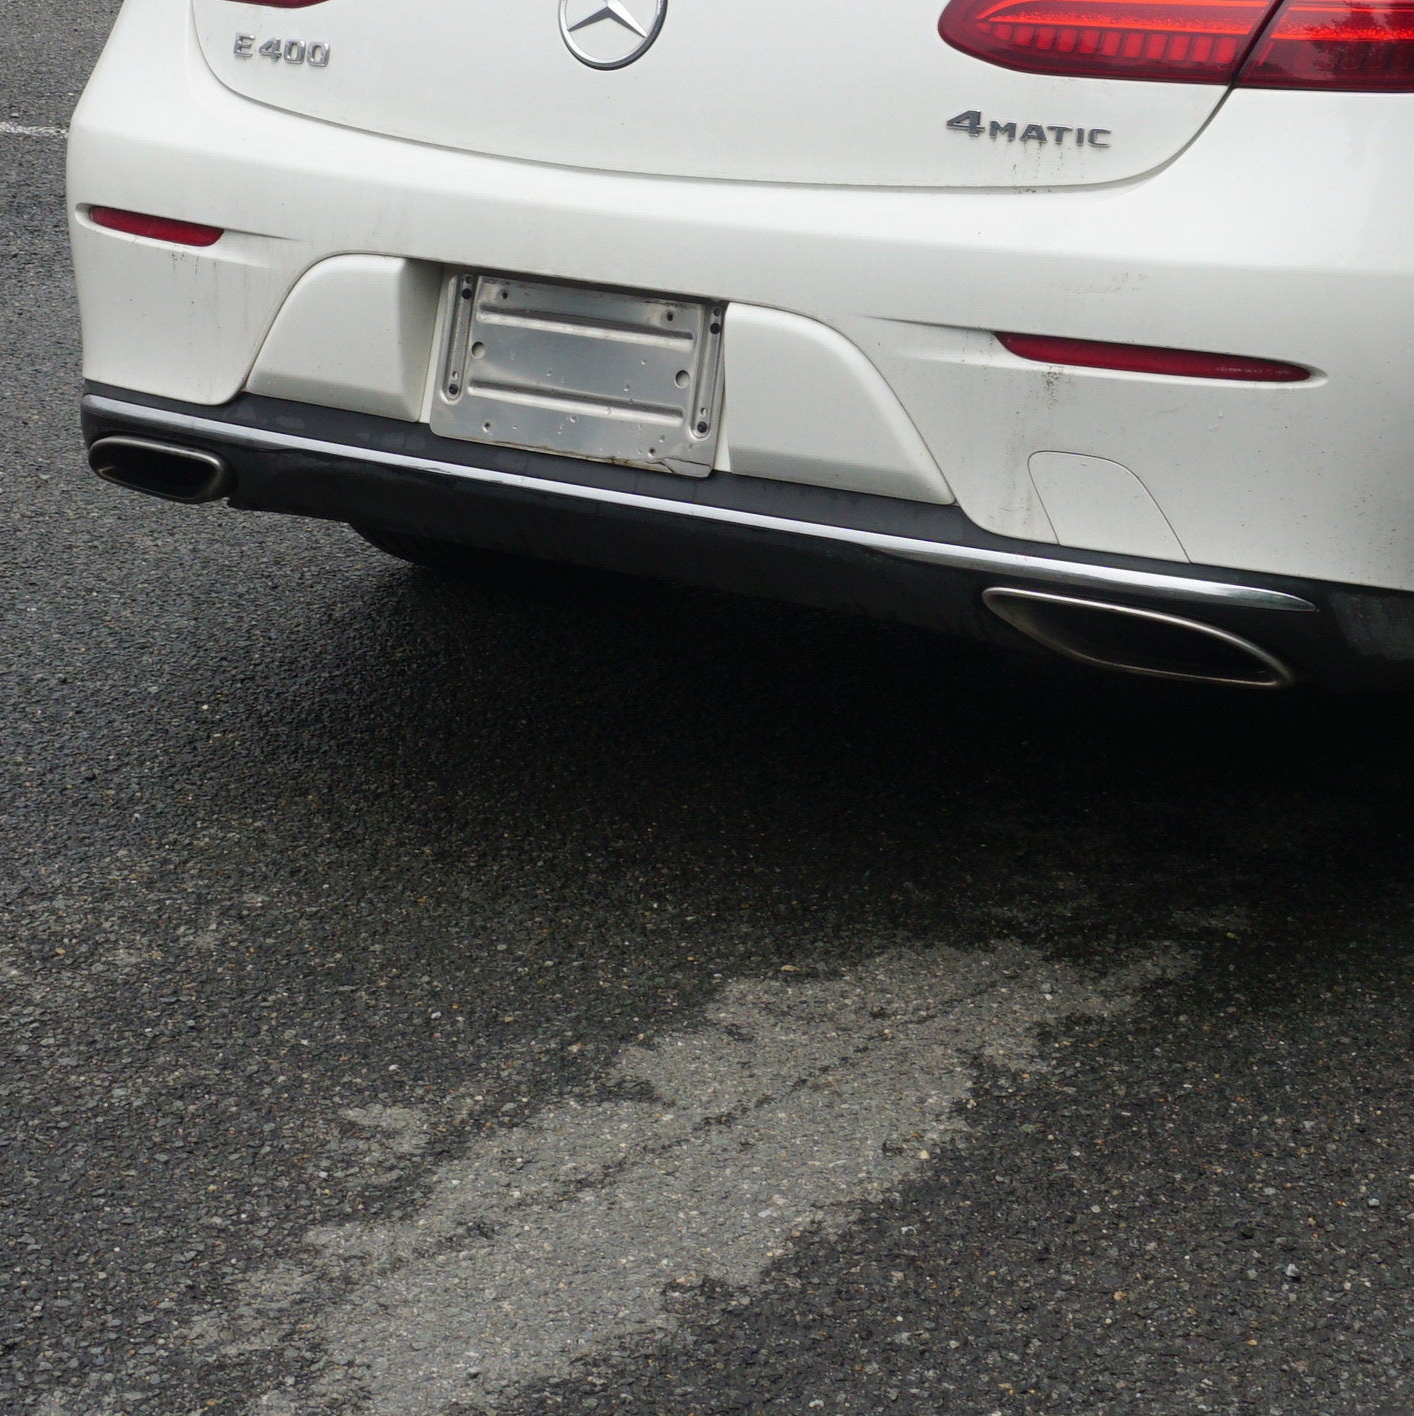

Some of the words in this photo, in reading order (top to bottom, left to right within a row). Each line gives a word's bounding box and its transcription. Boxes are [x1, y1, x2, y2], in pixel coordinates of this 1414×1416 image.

[233, 32, 256, 59] E
[258, 37, 331, 68] 400
[946, 109, 1112, 149] 4MATIC
